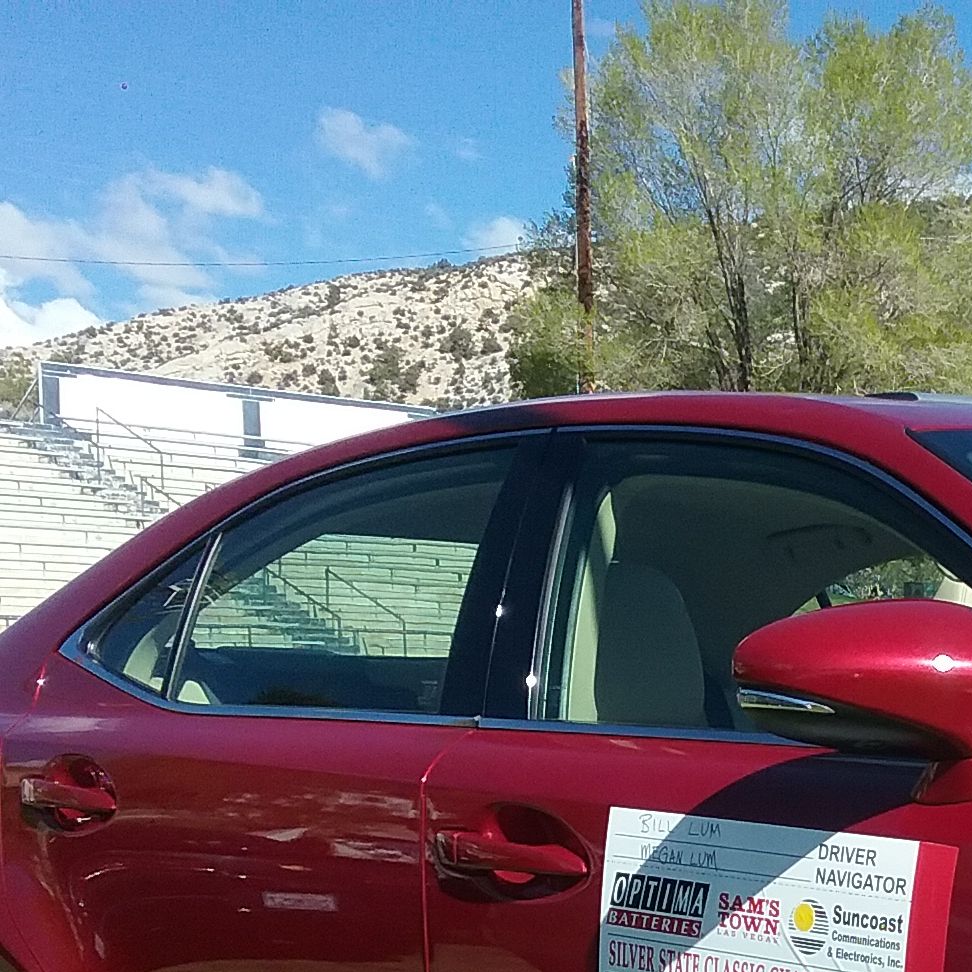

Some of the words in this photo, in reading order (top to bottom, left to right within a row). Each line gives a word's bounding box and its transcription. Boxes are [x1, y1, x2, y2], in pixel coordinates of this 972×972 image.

[639, 814, 674, 833] BILL
[688, 821, 721, 838] LUM
[640, 843, 683, 865] MEGAN
[690, 850, 718, 872] LUM
[818, 843, 877, 866] DRIVER
[815, 868, 907, 896] NAVIGATOR
[613, 876, 705, 915] OPTIMA
[719, 892, 780, 917] SAM'S
[609, 911, 700, 937] BATTERIES
[718, 911, 780, 935] TOWN
[833, 905, 903, 934] Suncoast
[717, 928, 736, 937] LAS
[832, 930, 901, 951] Communications
[608, 940, 654, 972] SILVER
[827, 947, 834, 958] &
[836, 948, 885, 968] Electronics,
[887, 956, 904, 969] Inc.
